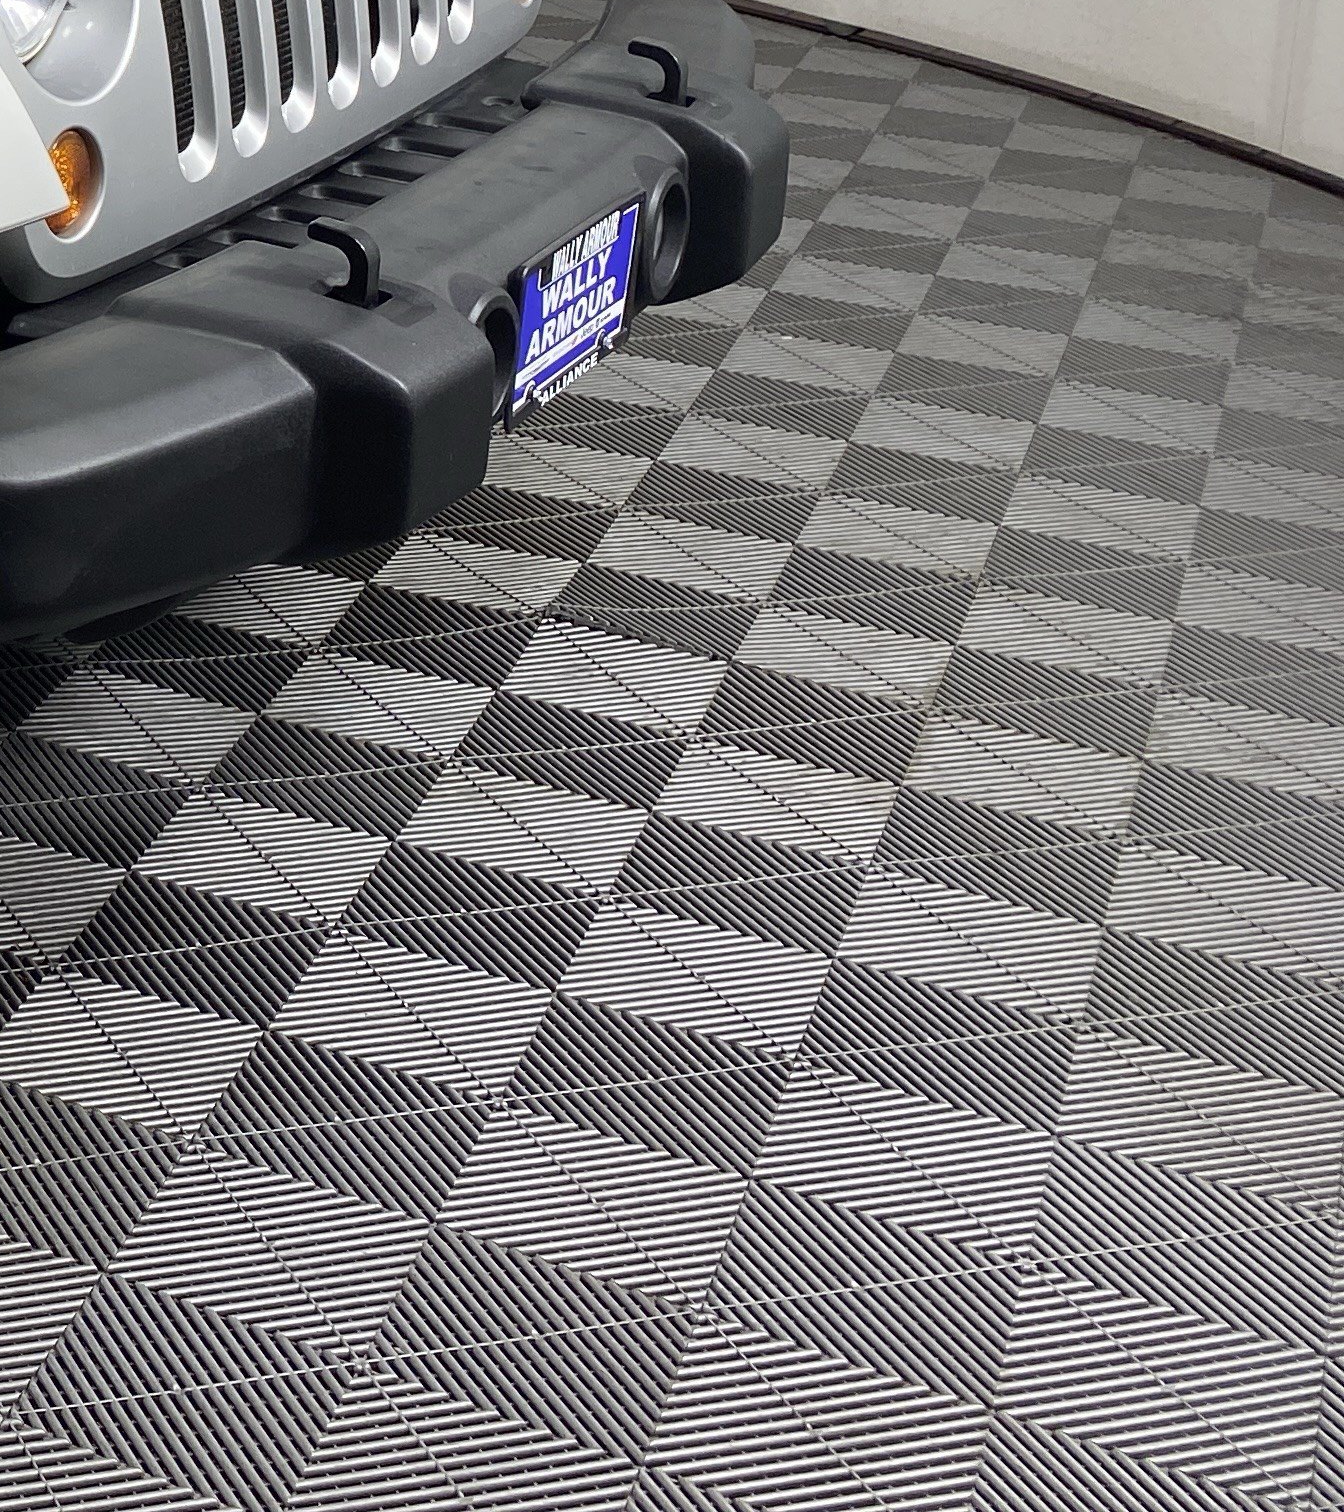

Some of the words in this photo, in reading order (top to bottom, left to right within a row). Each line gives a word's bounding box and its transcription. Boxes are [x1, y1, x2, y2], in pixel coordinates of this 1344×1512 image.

[541, 245, 614, 319] WALLY
[551, 234, 583, 281] WALLY
[524, 276, 617, 365] ARMOUR
[541, 351, 599, 406] ALLIANCE
